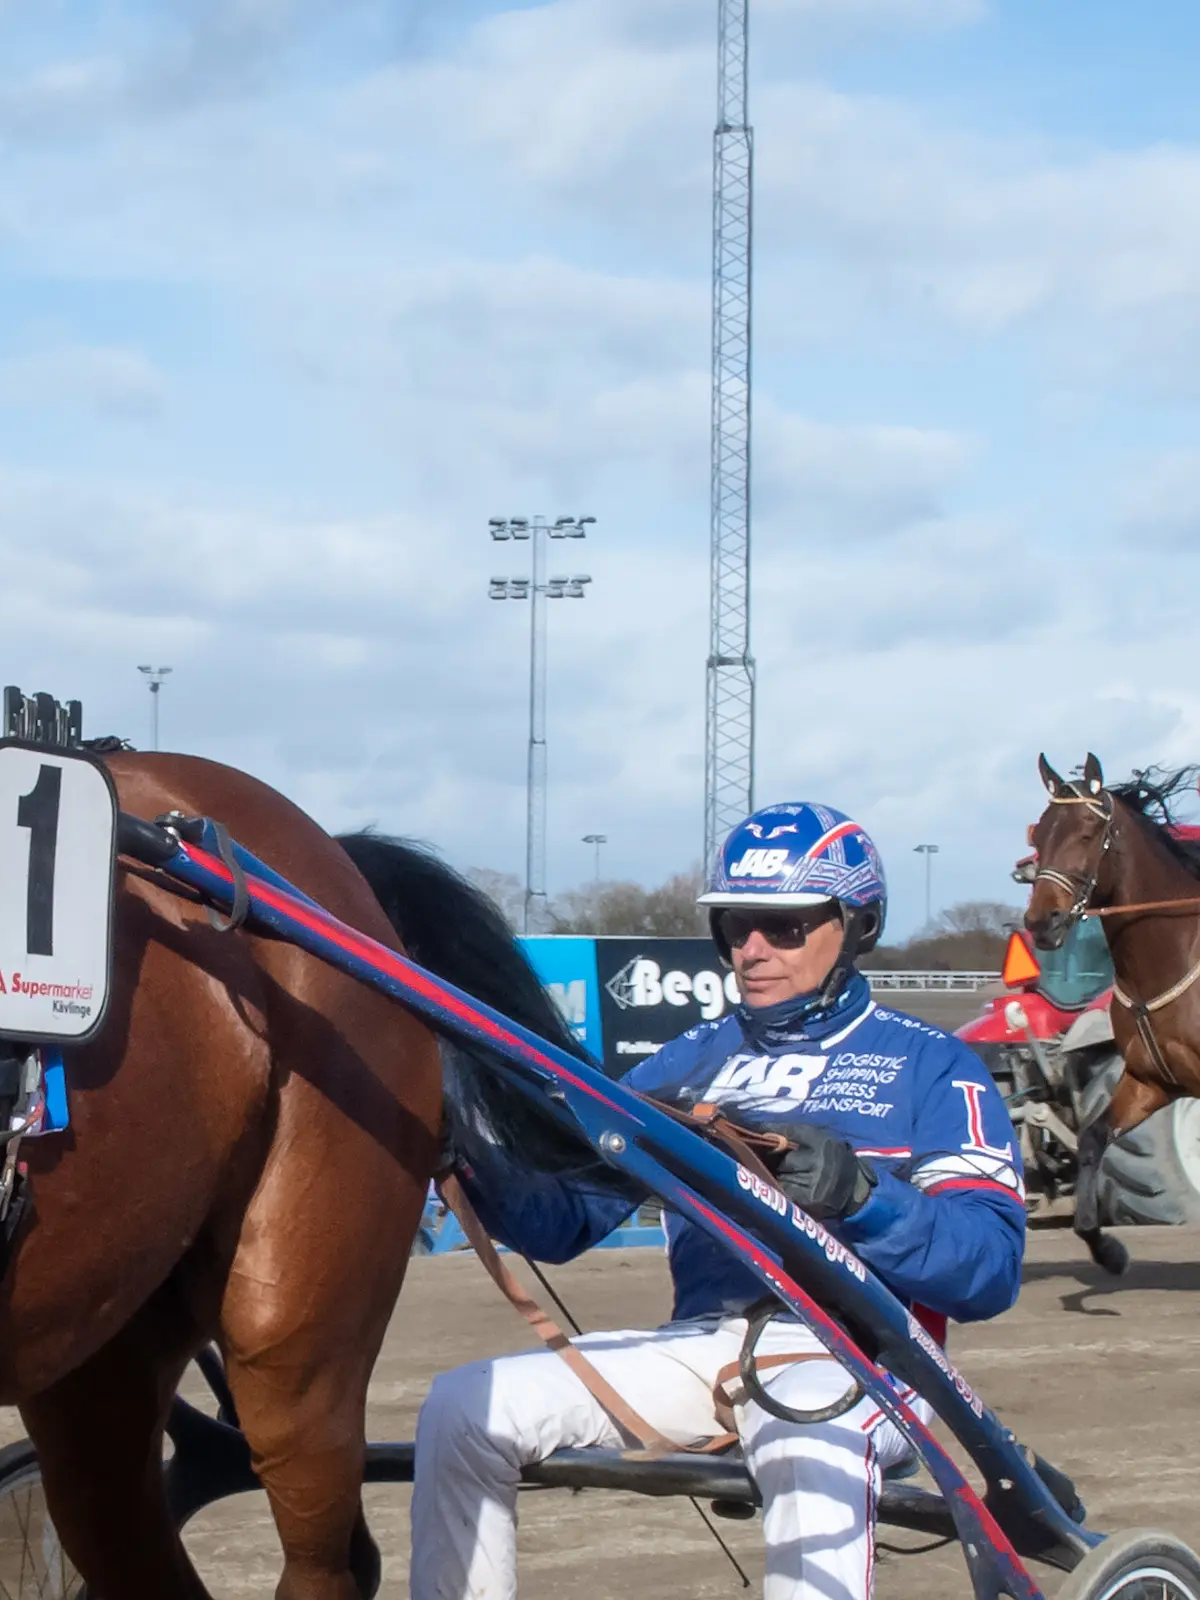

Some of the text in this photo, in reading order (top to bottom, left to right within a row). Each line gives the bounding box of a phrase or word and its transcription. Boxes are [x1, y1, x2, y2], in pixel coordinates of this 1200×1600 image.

[17, 764, 62, 956] 1
[730, 849, 789, 877] JAB
[11, 972, 93, 999] Supermarket
[832, 1052, 908, 1070] LOGISTIC
[823, 1067, 898, 1084] SHIPPING
[810, 1082, 878, 1099] EXPRESS
[802, 1098, 894, 1118] TRANSPORT
[951, 1080, 1013, 1162] L
